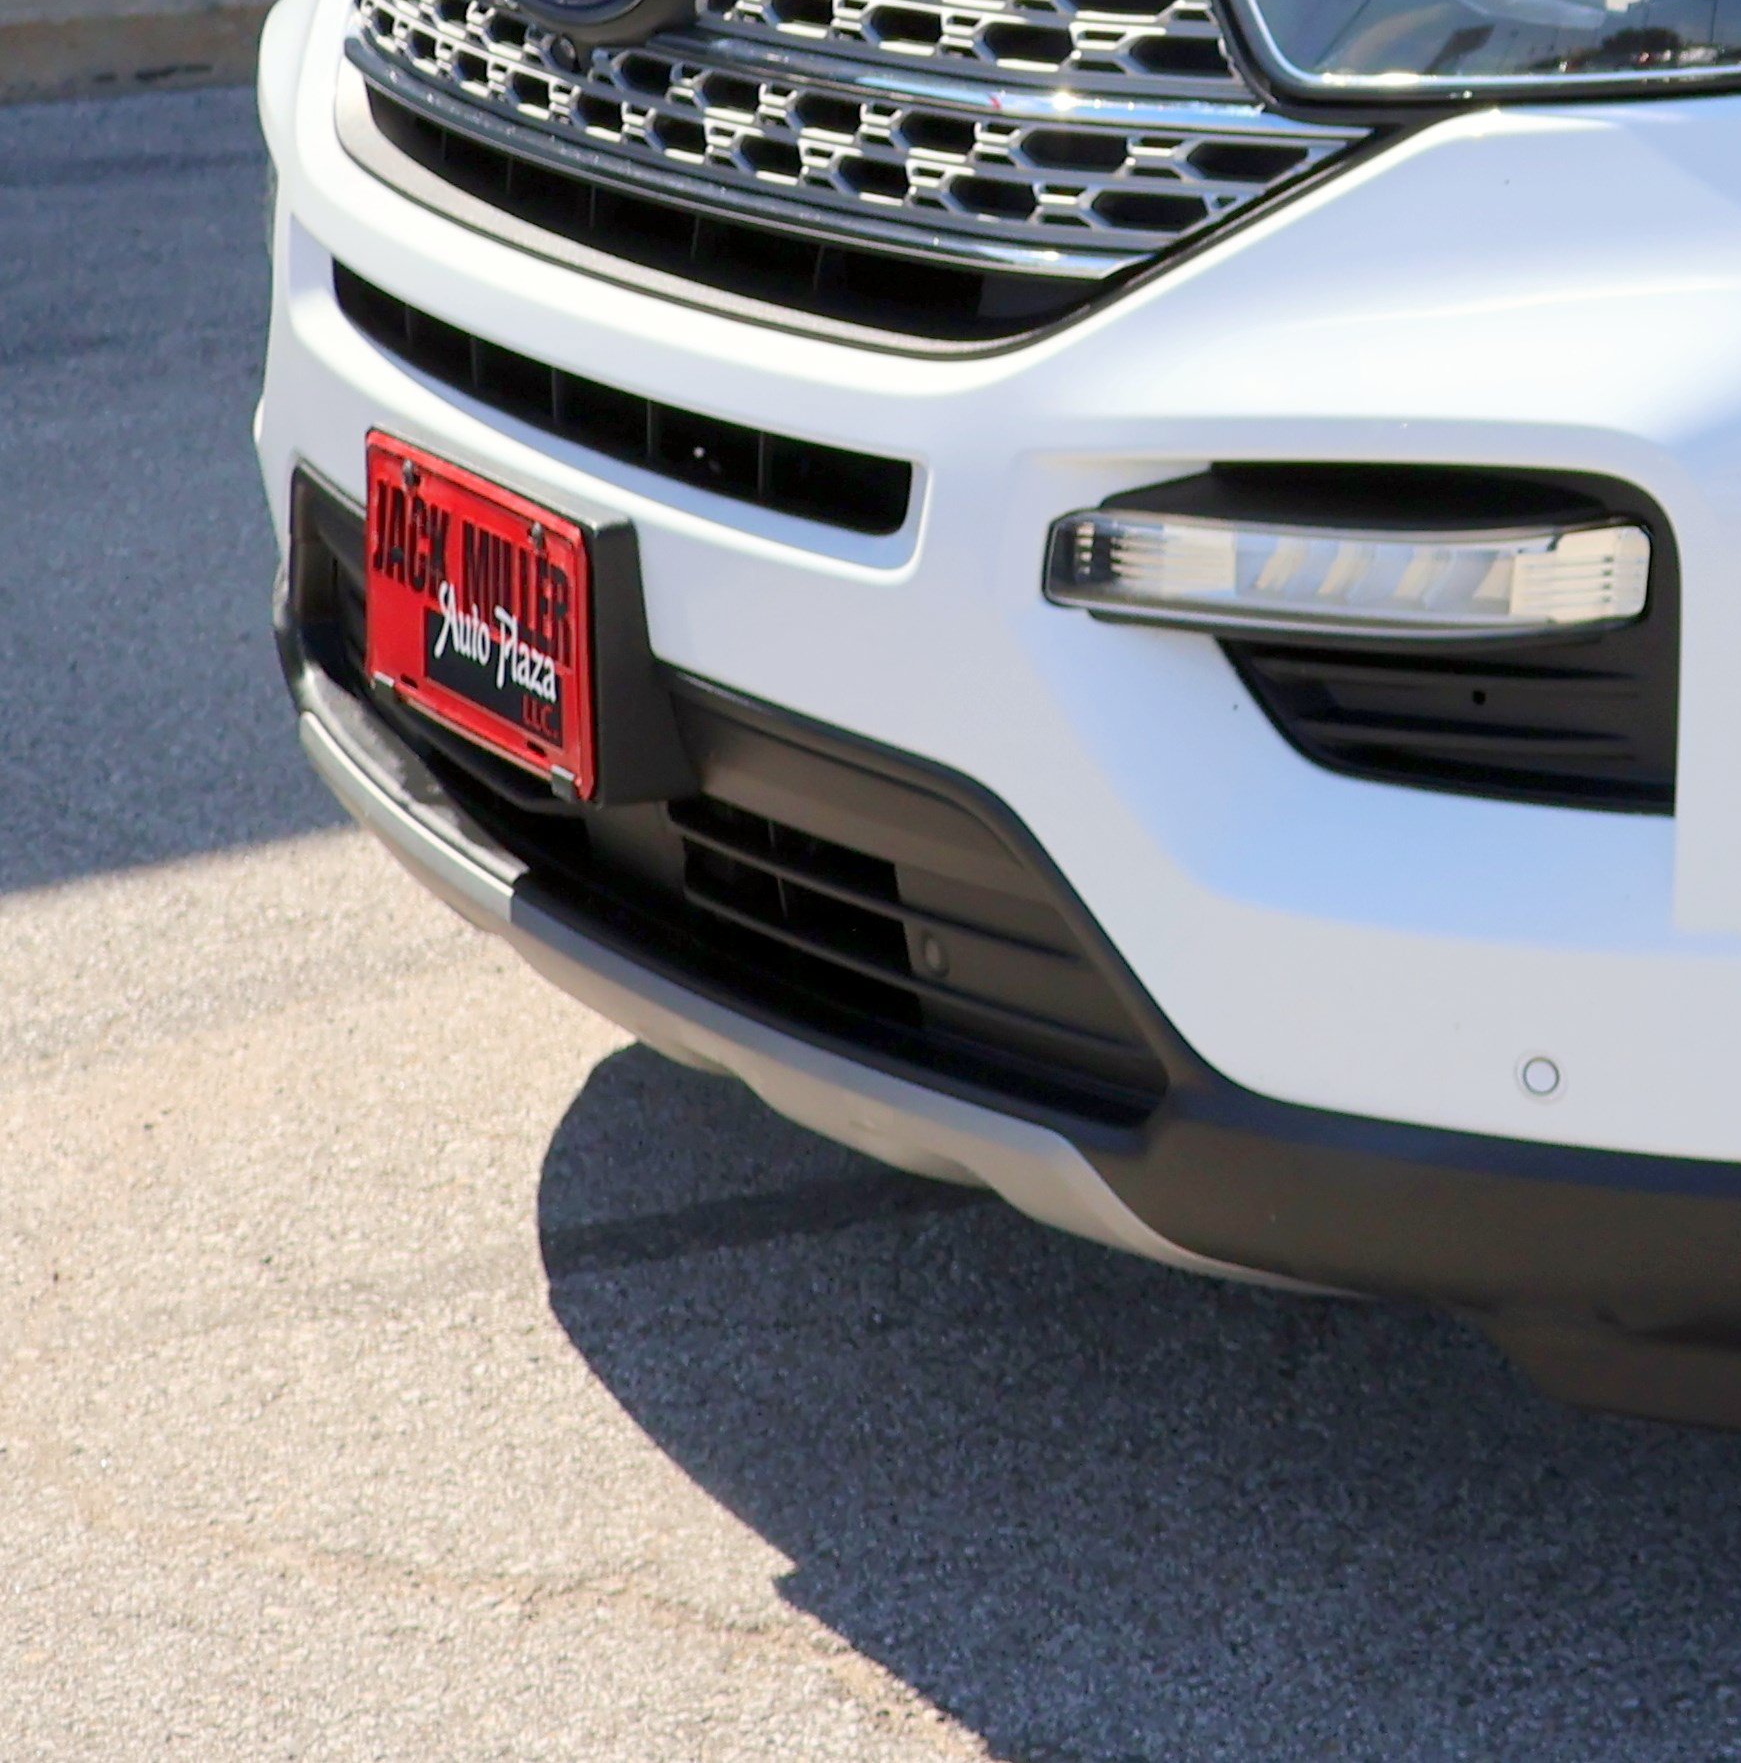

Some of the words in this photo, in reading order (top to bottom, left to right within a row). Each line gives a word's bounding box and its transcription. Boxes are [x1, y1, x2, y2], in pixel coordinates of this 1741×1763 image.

[372, 479, 451, 601] JACK
[459, 518, 573, 670] MILLER
[433, 580, 493, 667] Auto
[493, 605, 558, 703] Plaza
